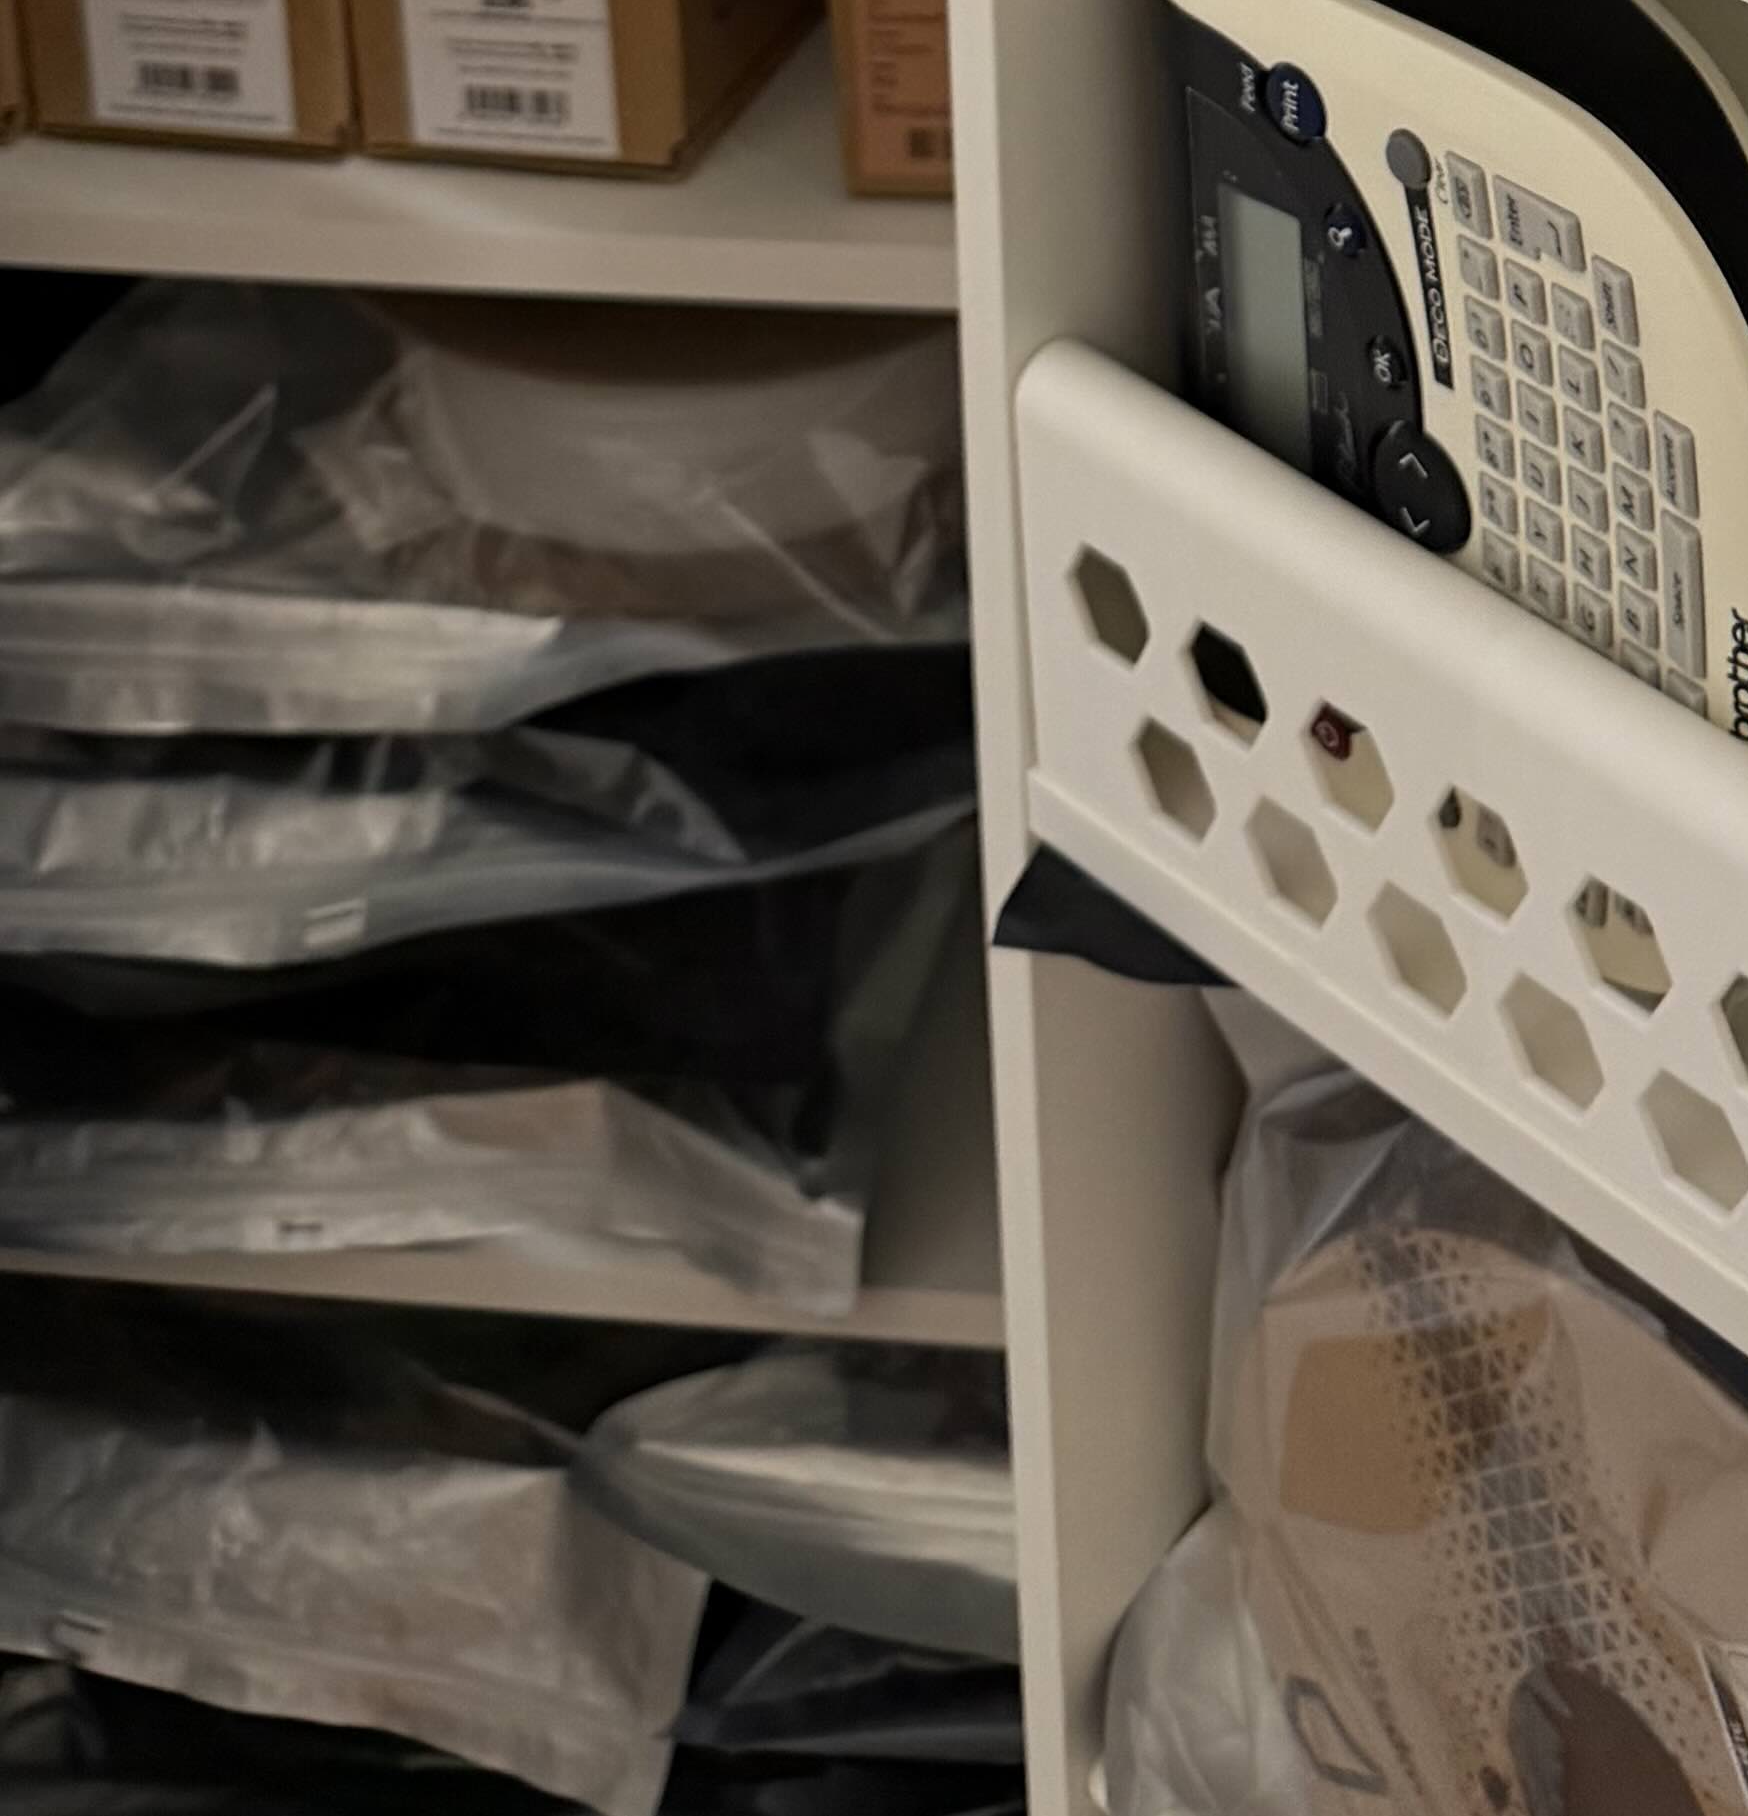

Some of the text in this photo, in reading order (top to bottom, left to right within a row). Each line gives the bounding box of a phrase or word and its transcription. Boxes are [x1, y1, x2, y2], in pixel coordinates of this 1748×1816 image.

[1240, 62, 1257, 111] Feed
[1281, 79, 1300, 131] Print
[1505, 192, 1524, 245] Enter
[1414, 205, 1450, 364] DECO MODE
[1602, 281, 1617, 328] Shift
[1373, 350, 1393, 383] OK
[1571, 430, 1585, 455] K
[1661, 432, 1678, 507] Accent
[1620, 484, 1635, 518] M
[1623, 545, 1638, 575] N
